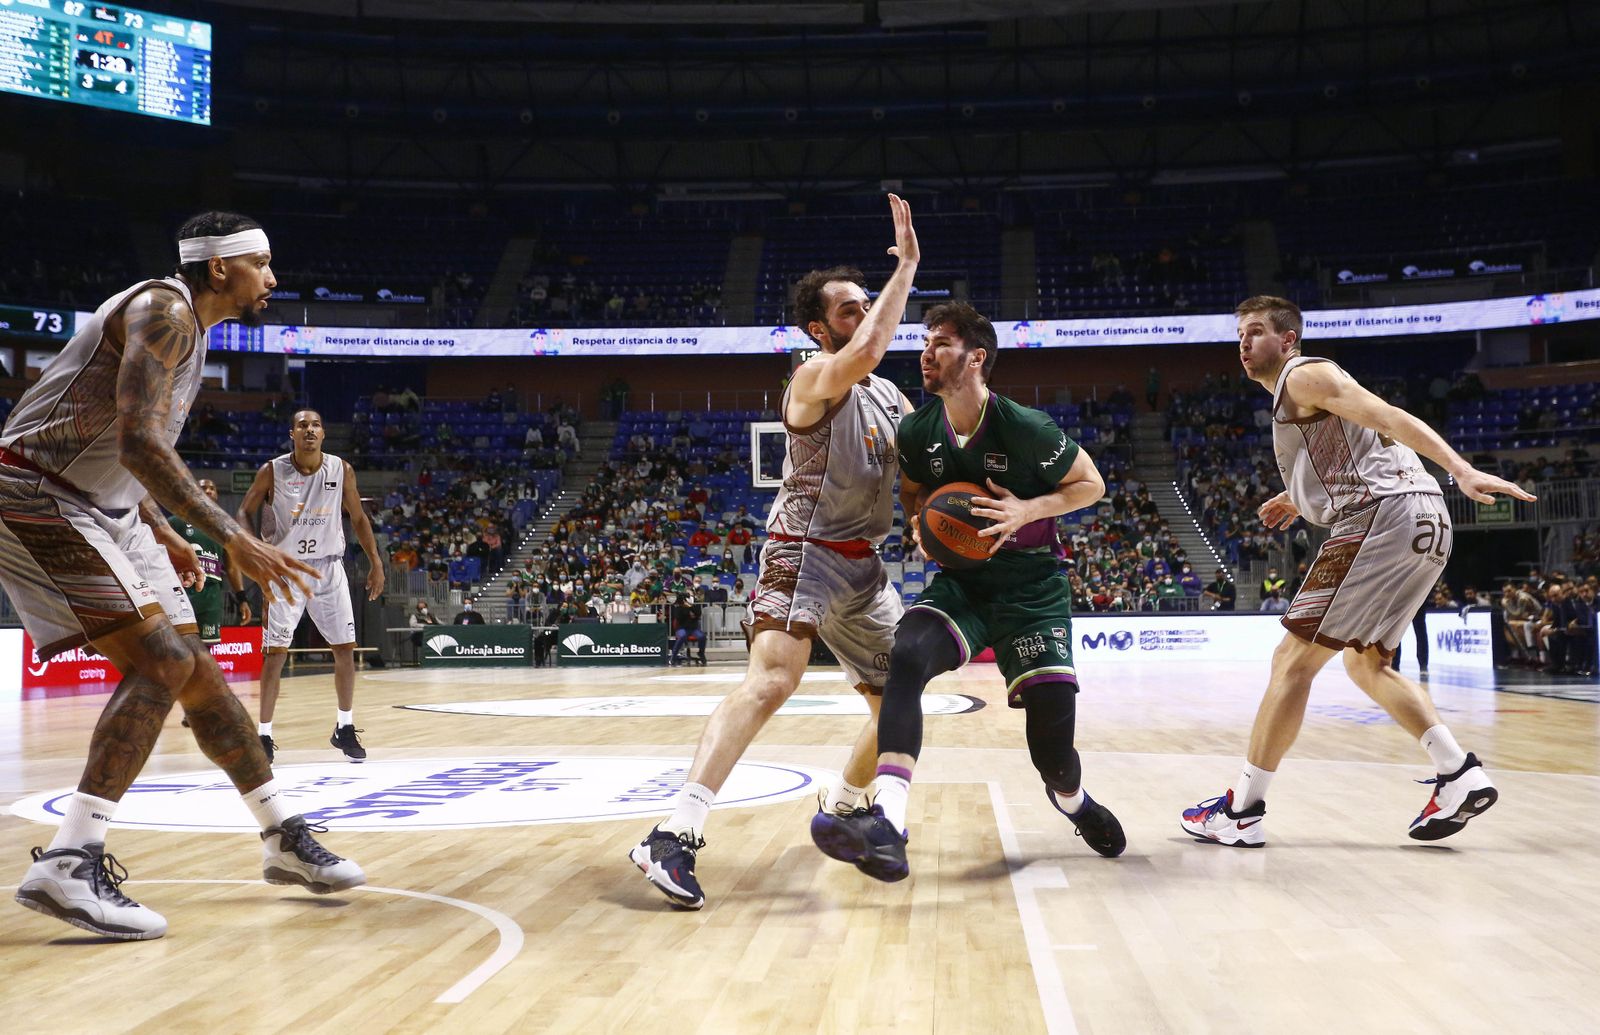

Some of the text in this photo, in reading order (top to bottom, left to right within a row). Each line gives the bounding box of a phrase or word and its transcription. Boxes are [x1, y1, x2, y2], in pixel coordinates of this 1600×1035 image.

[124, 12, 144, 29] 73
[94, 30, 115, 45] 4T
[82, 73, 127, 94] 3 4
[33, 311, 63, 333] 73
[1306, 314, 1442, 329] Respetar distancia de seg
[1056, 325, 1185, 338] Respetar distancia de seg
[325, 336, 455, 347] Respetar distancia de seg
[572, 336, 698, 346] Respetar distancia de seg
[292, 518, 326, 526] BURGOS
[1415, 512, 1437, 520] GRUPO
[1411, 513, 1450, 557] at
[297, 539, 316, 554] 32
[213, 642, 253, 656] FRANCISQUITA
[455, 645, 525, 656] Unicaja Banco
[591, 644, 661, 656] Unicaja Banco
[303, 760, 560, 821] PEDRIZAS
